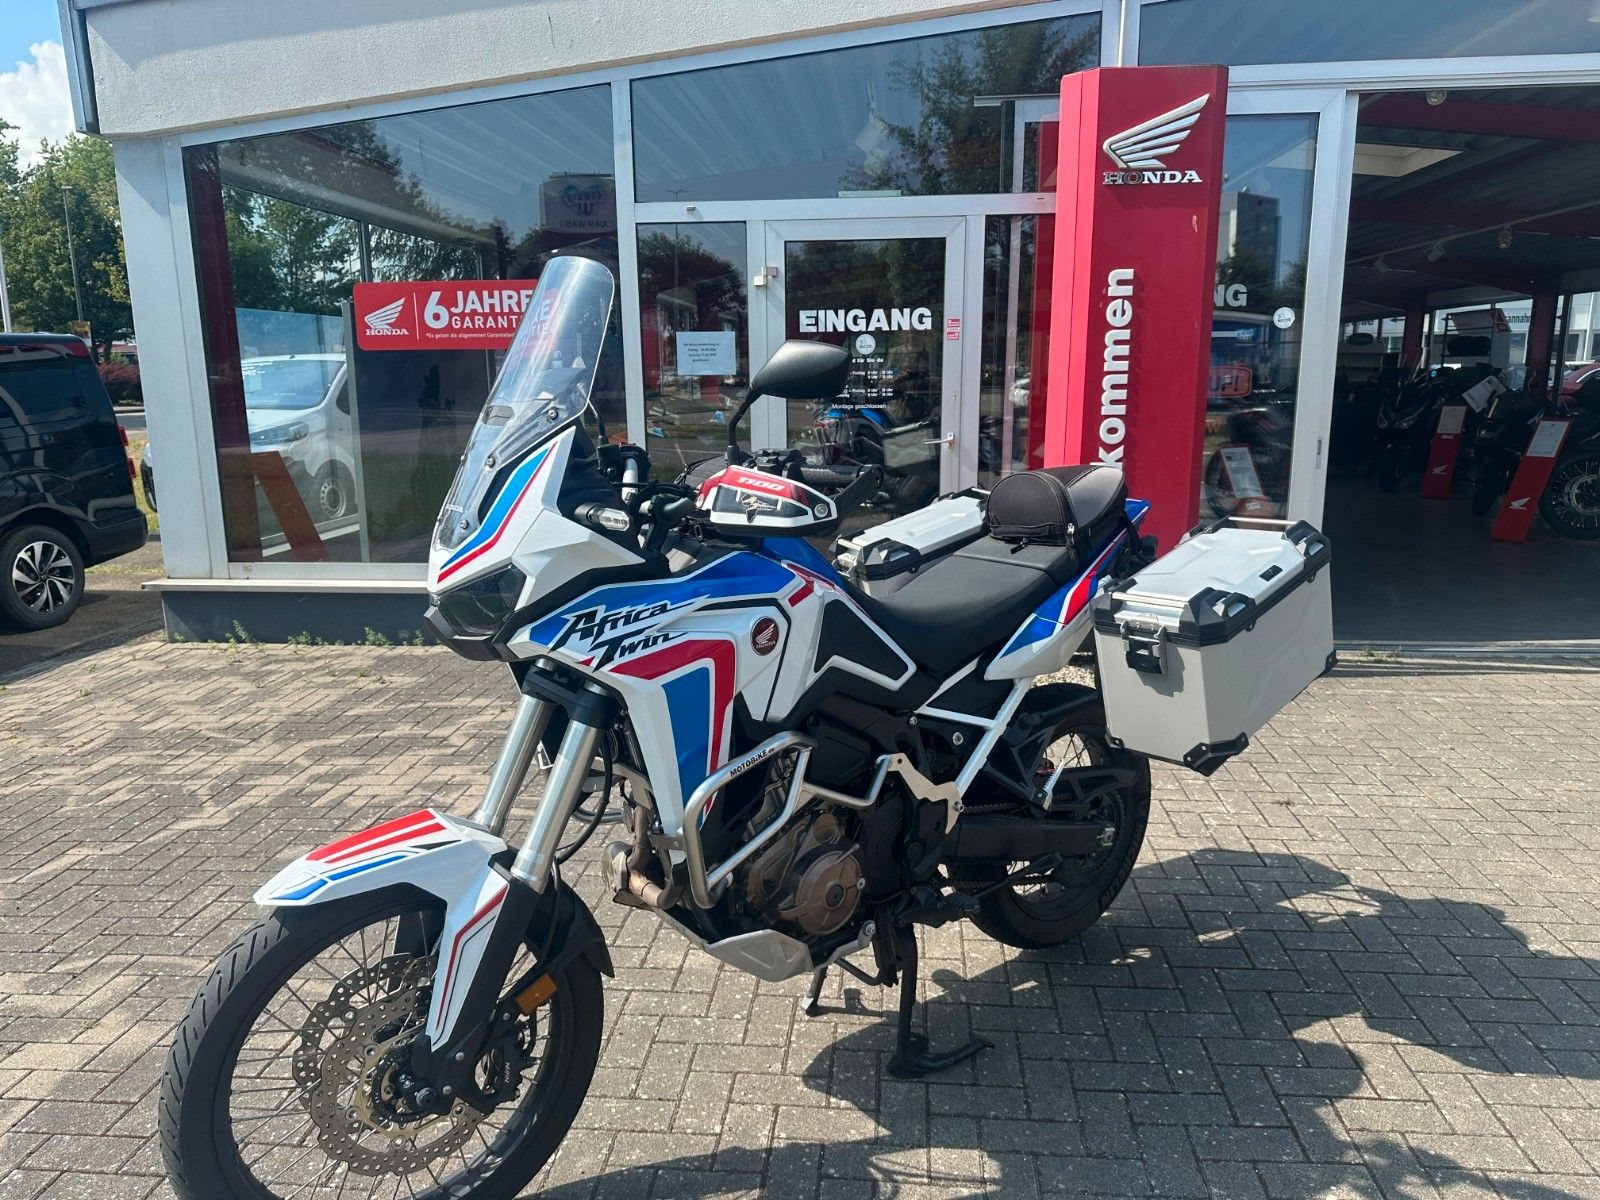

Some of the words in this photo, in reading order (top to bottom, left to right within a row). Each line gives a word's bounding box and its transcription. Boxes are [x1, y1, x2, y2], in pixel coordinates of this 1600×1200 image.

[1103, 171, 1202, 185] HONDA
[424, 291, 449, 329] 6
[799, 307, 932, 332] EINGANG
[366, 328, 410, 336] HONDA
[547, 601, 695, 653] Africa
[588, 623, 689, 673] Twin
[755, 640, 776, 649] HONDA
